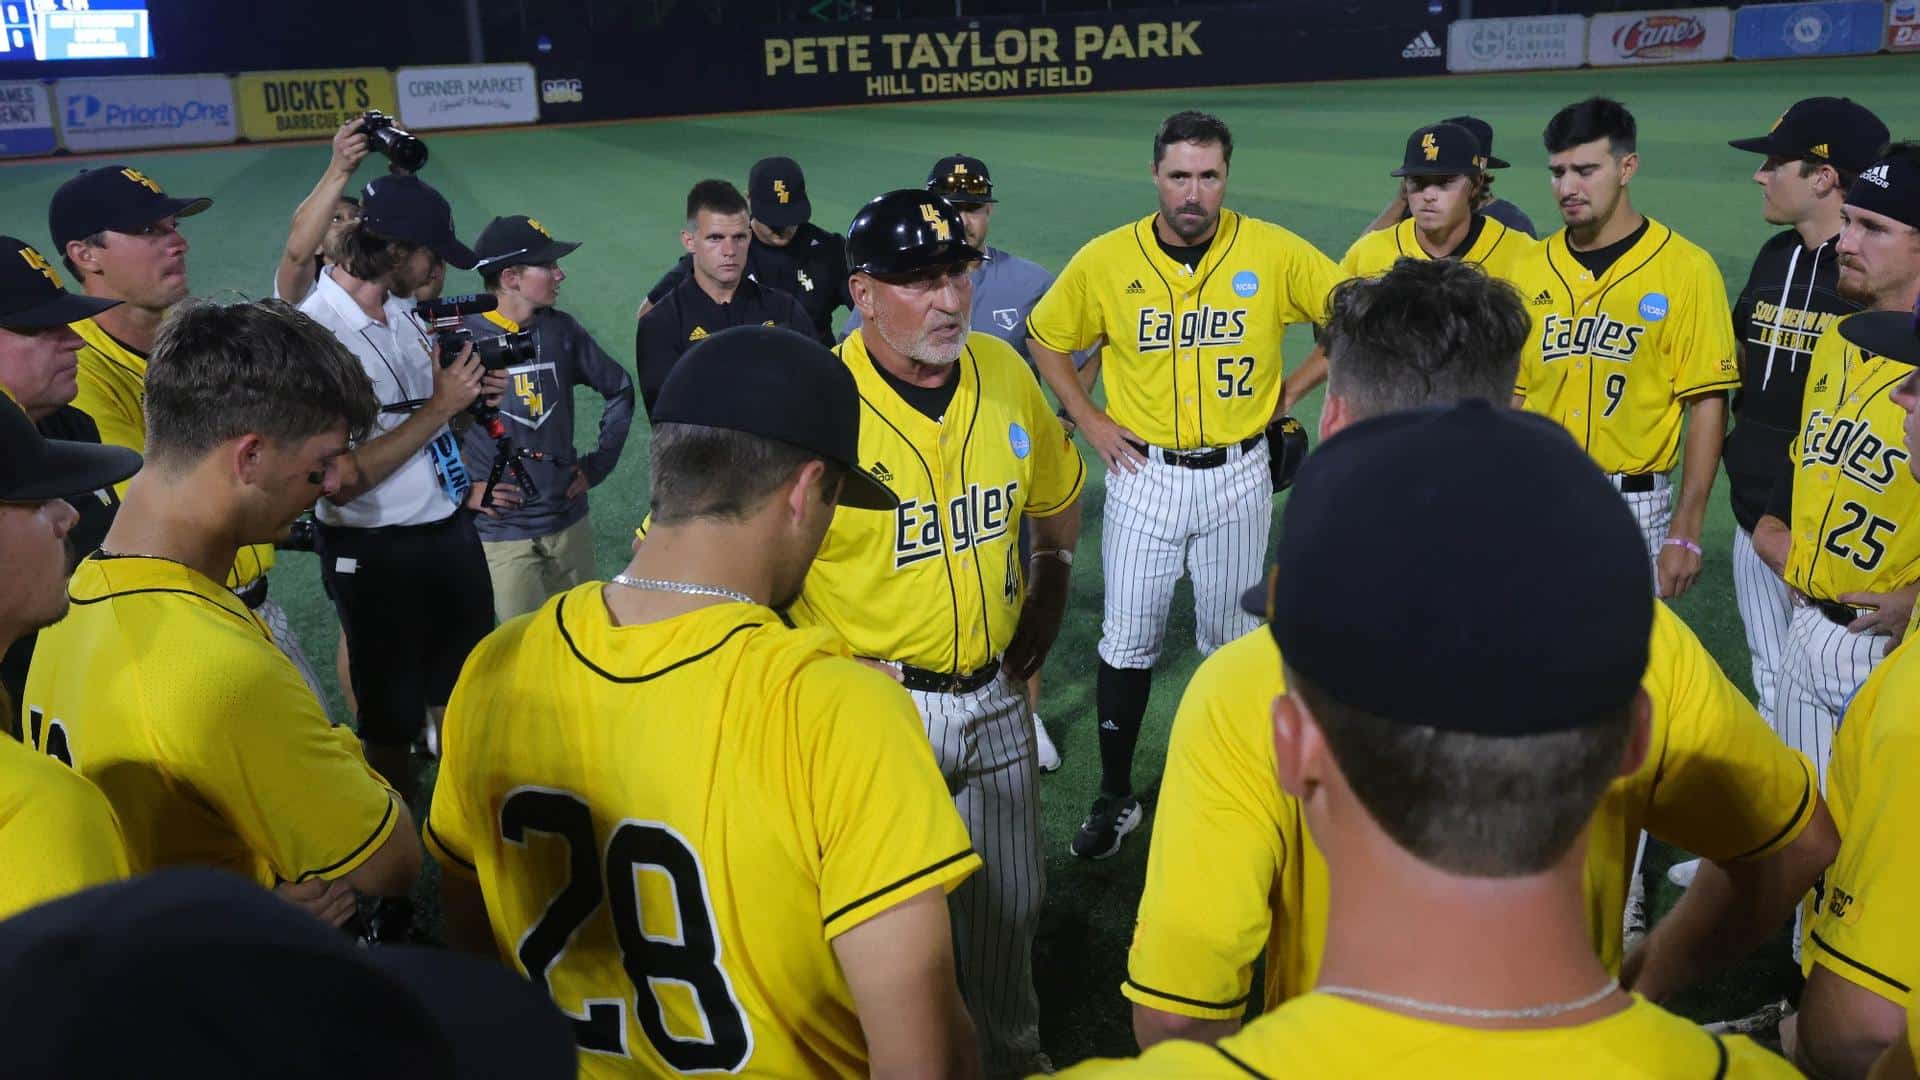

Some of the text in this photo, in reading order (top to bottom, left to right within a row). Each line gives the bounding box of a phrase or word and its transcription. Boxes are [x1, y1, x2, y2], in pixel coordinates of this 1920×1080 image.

[764, 20, 1202, 76] PETE TAYLOR PARK
[264, 78, 370, 112] DICKEY'S
[409, 77, 525, 97] CORNER MARKET
[866, 66, 1093, 97] HILL DENSON FIELD
[106, 100, 229, 128] PriorityOne
[1138, 305, 1247, 348] Eagles
[1541, 312, 1645, 355] Eagles
[1217, 356, 1256, 399] 52
[1603, 373, 1626, 417] 9
[1803, 411, 1909, 485] Eagles
[896, 482, 1019, 554] Eagles
[1824, 501, 1898, 571] 25
[500, 784, 754, 1075] 28
